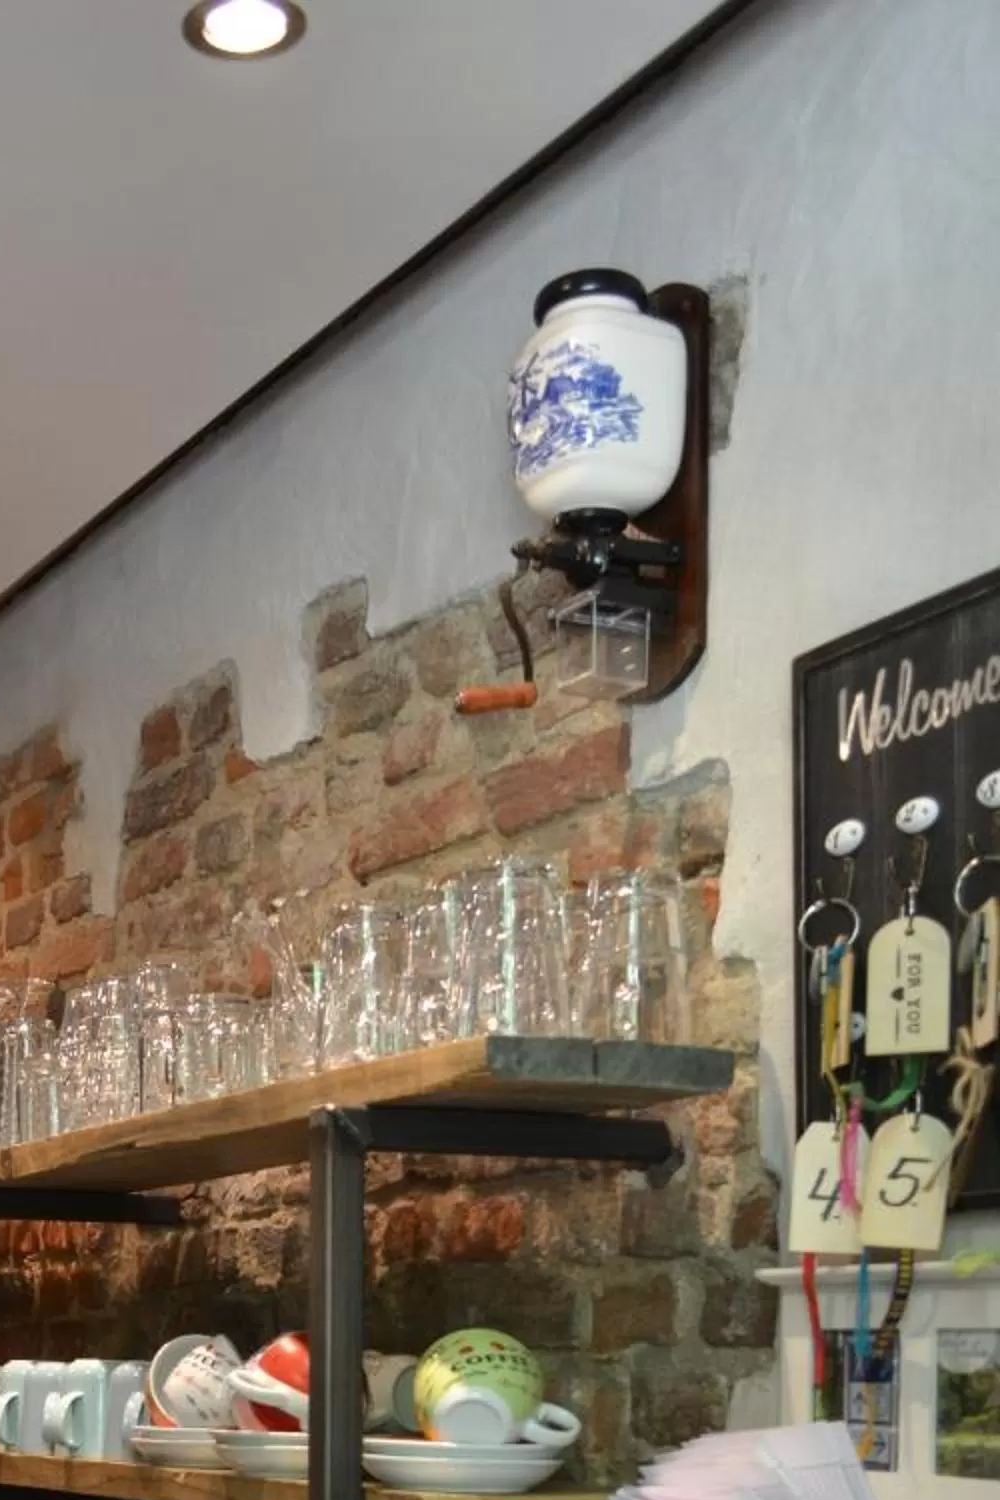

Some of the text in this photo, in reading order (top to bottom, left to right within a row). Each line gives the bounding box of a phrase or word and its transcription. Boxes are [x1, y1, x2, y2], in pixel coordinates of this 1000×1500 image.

[838, 654, 1000, 762] Welcome
[906, 953, 922, 1034] FOR YOU
